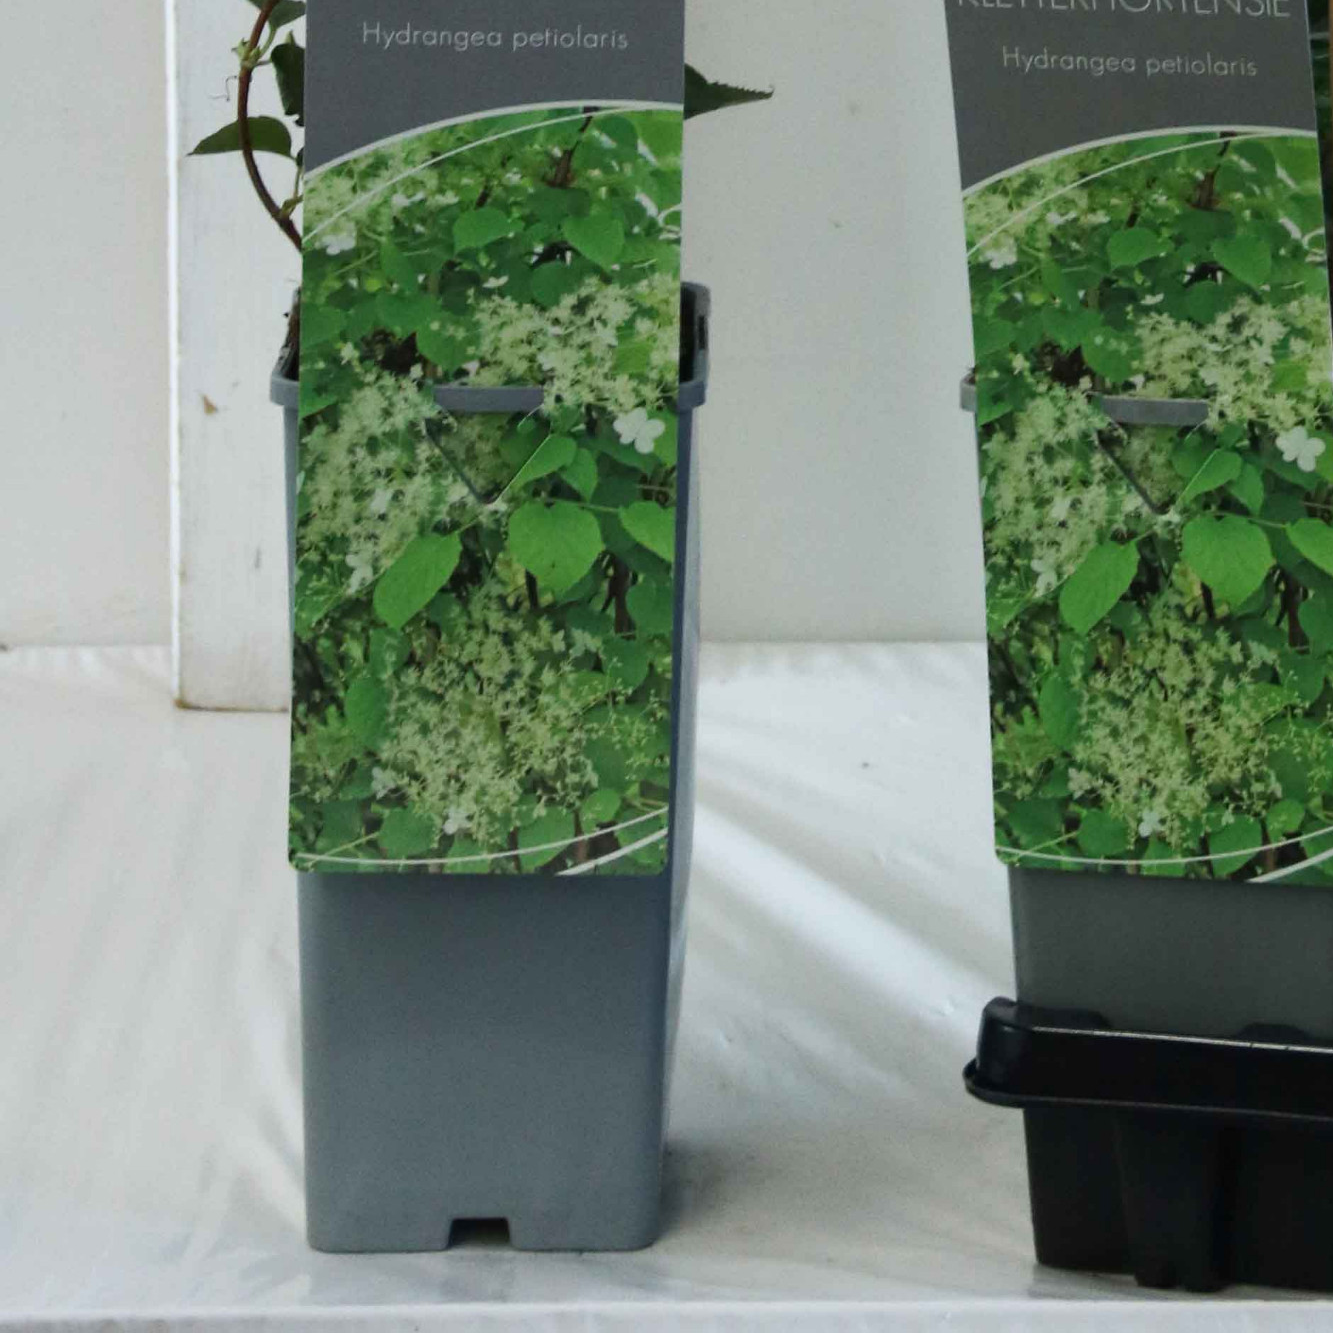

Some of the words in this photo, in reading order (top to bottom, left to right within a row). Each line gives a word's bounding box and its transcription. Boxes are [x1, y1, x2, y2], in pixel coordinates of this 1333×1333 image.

[362, 21, 502, 52] Hydrangea
[512, 24, 630, 52] petiolaris
[1002, 45, 1137, 77] Hydrangea
[1146, 52, 1258, 79] petiolaris
